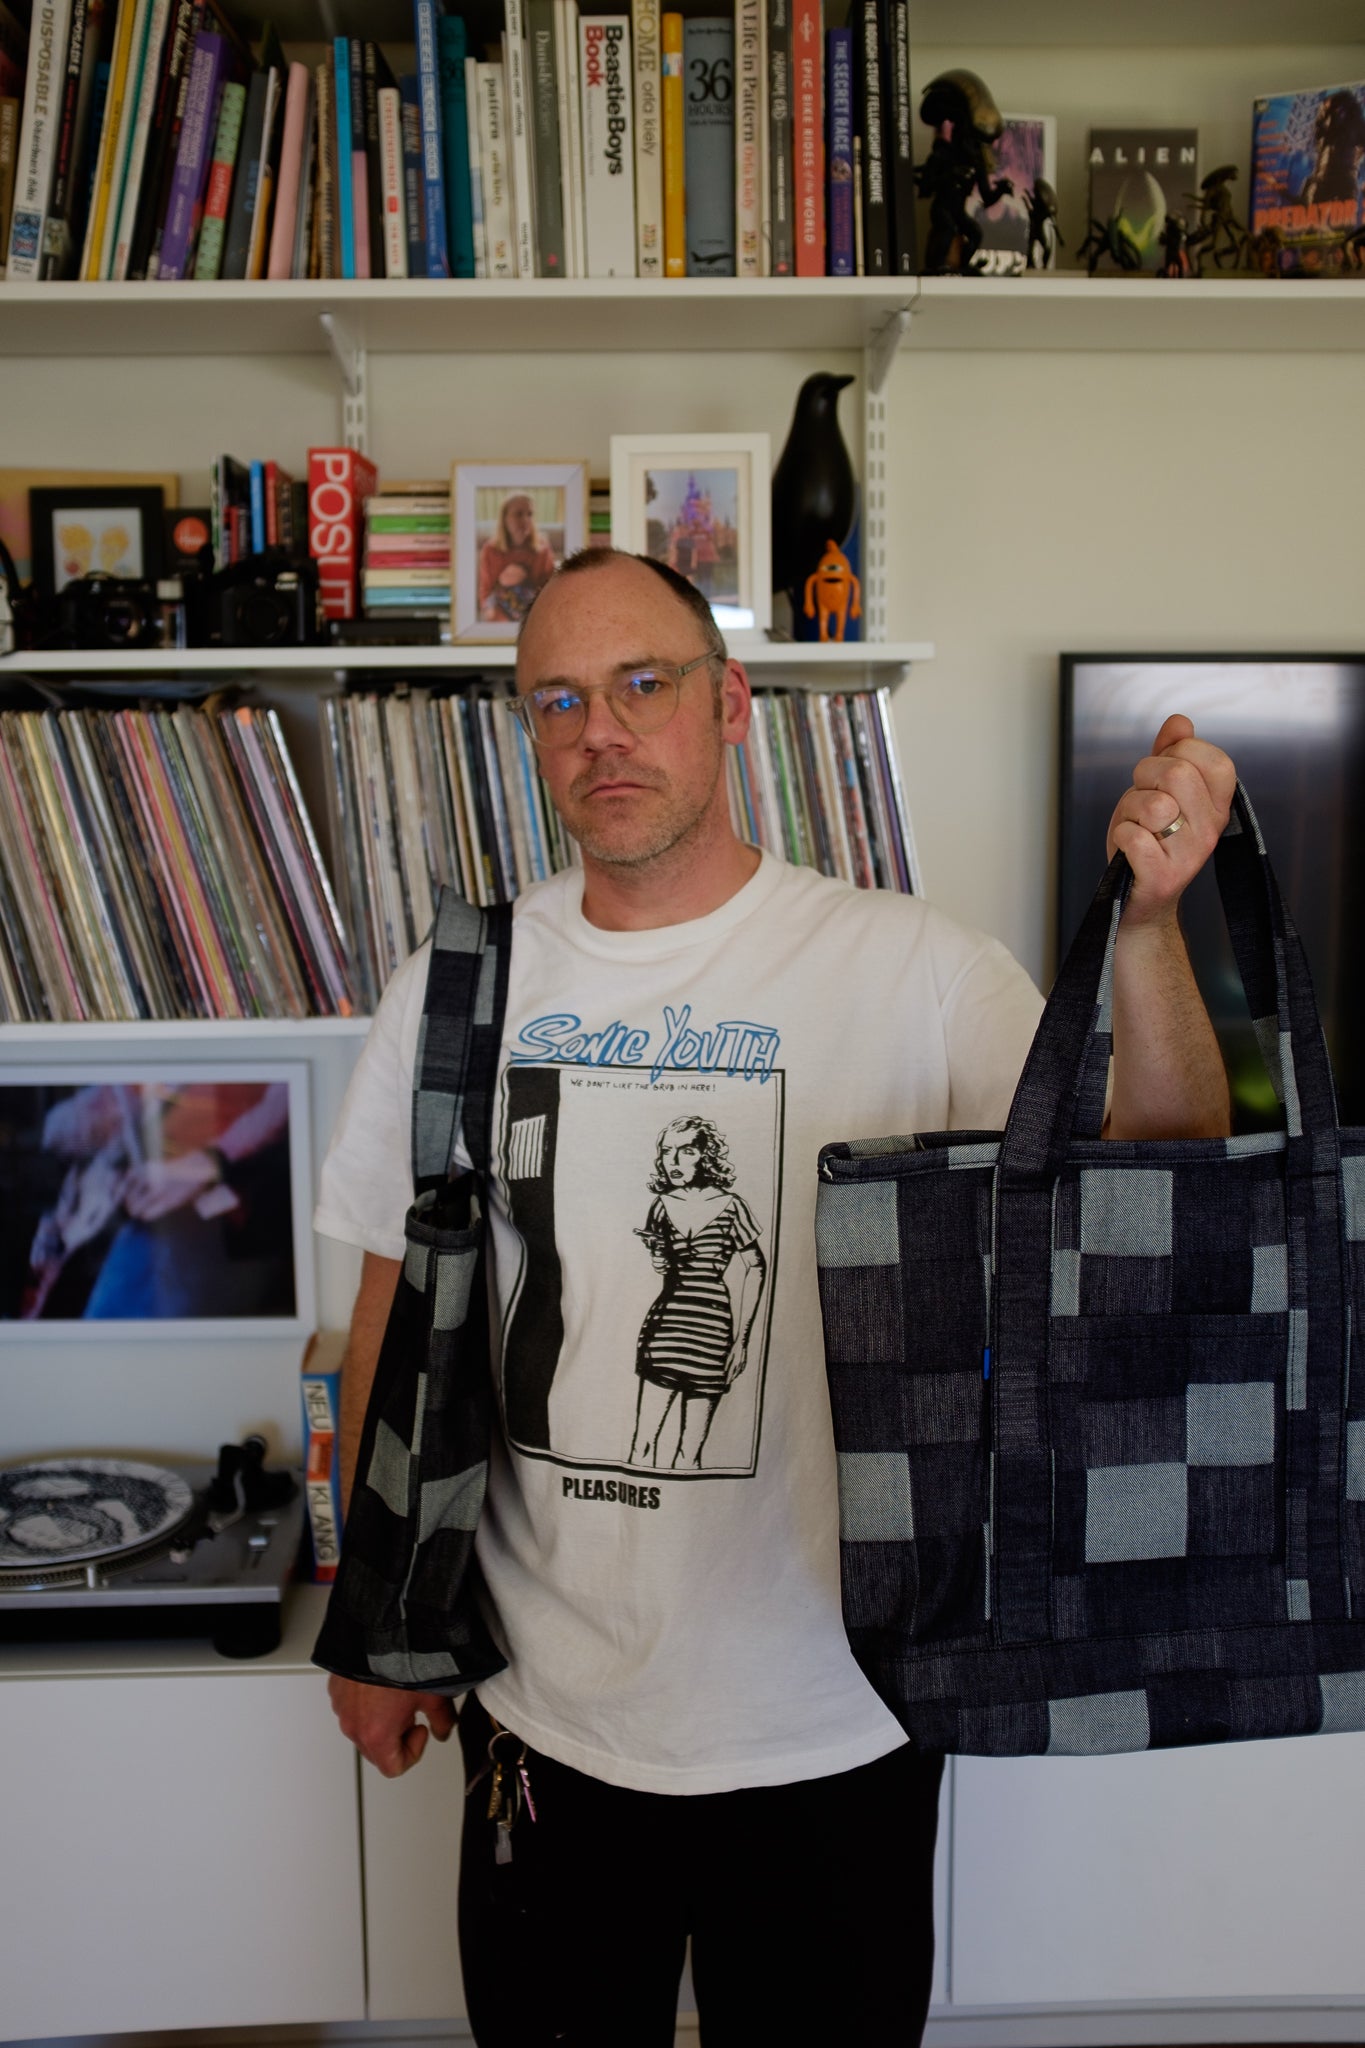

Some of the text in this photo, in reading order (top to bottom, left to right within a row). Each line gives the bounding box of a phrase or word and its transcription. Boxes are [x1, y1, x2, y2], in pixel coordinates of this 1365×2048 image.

[865, 2, 878, 21] THE
[743, 15, 758, 49] Life
[34, 8, 54, 115] DISPOSABLE
[585, 25, 606, 88] Book
[743, 54, 758, 71] in
[801, 58, 813, 88] EPIC
[642, 81, 657, 113] orla
[689, 58, 733, 103] 36
[833, 41, 850, 152] THE SECRET RACE
[742, 77, 758, 142] Pattern
[802, 94, 814, 124] BIKE
[867, 95, 882, 158] FELLOWSHIP
[641, 118, 657, 156] kiely
[803, 128, 815, 166] RIDES
[1090, 146, 1196, 164] ALIEN
[868, 160, 883, 203] ARCHIVE
[804, 196, 816, 245] WORLD
[1254, 199, 1357, 235] PREDATOR
[650, 1004, 782, 1086] YOUTH
[570, 1078, 582, 1087] WE
[586, 1080, 610, 1088] DON'T
[613, 1081, 631, 1089] LIKE
[307, 1384, 332, 1431] NEU
[562, 1475, 661, 1510] PLEASURES
[311, 1486, 337, 1562] KLANG
